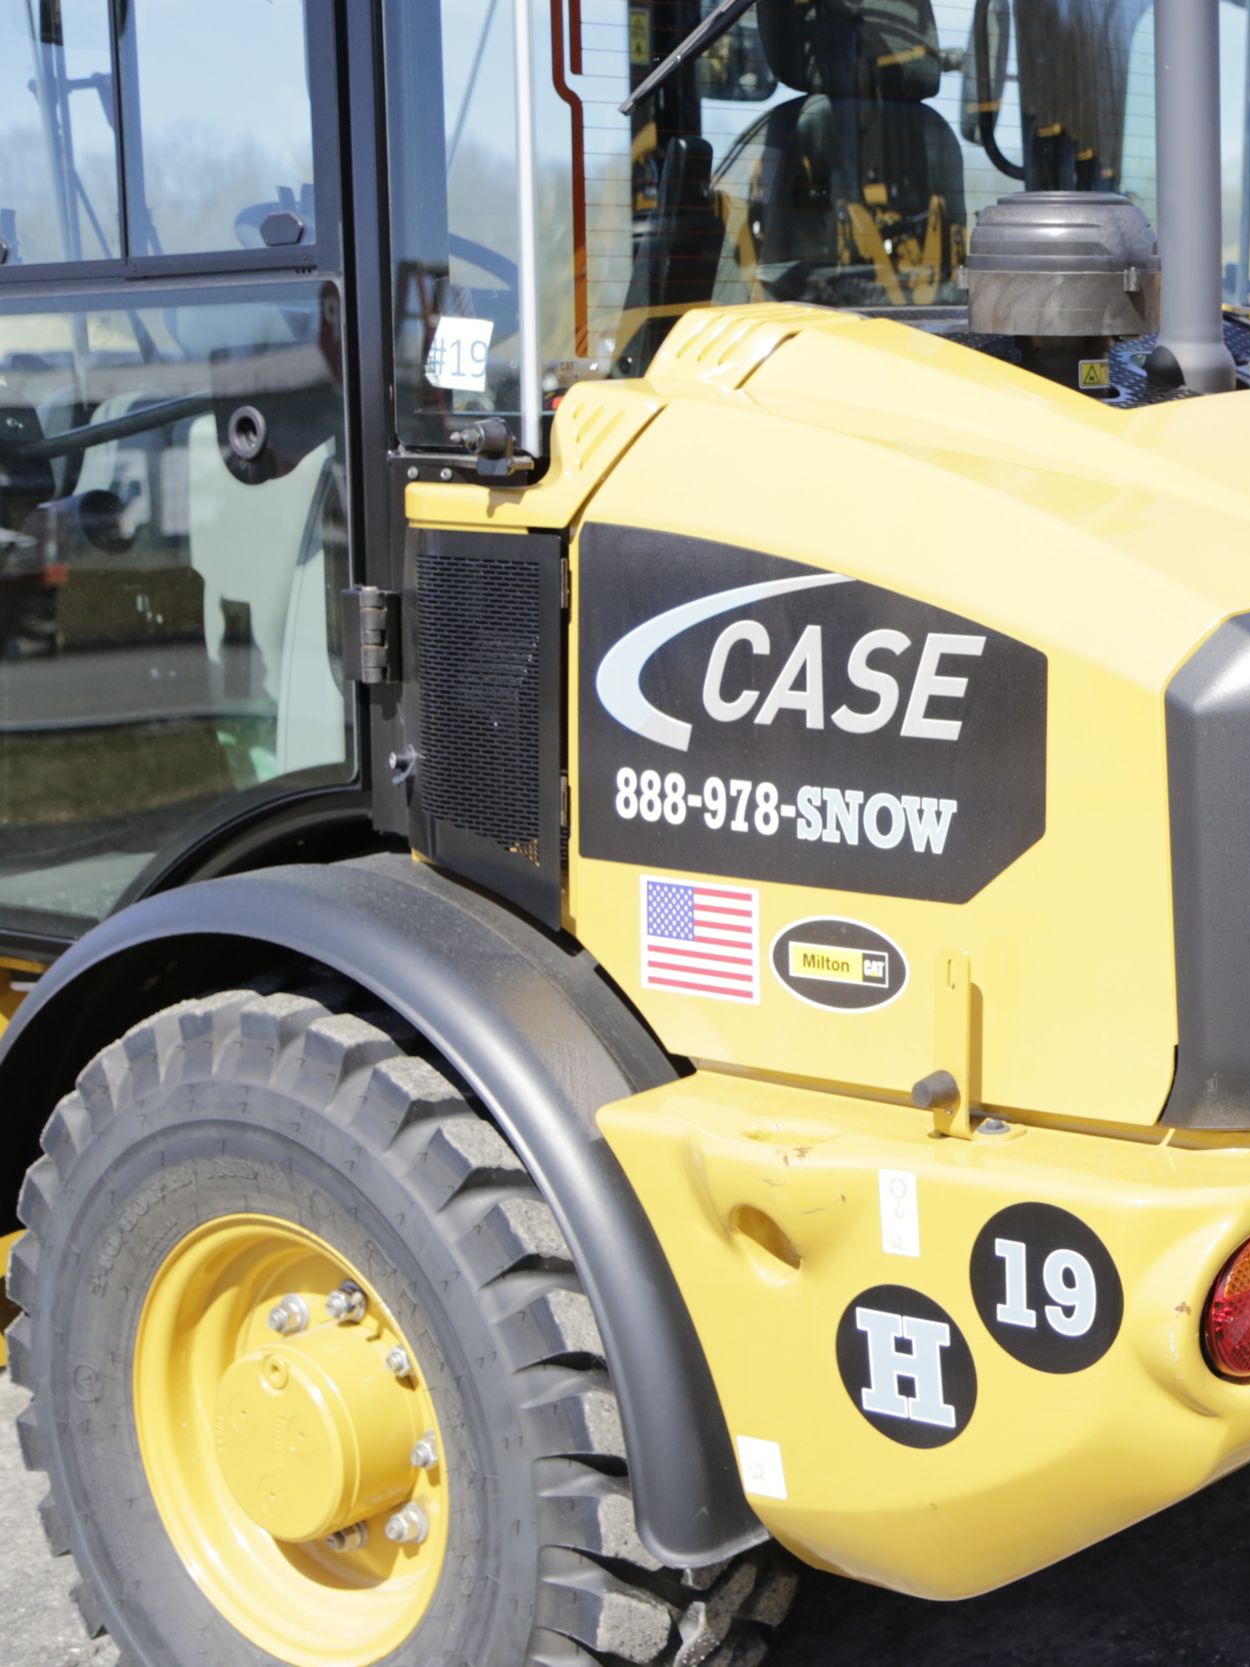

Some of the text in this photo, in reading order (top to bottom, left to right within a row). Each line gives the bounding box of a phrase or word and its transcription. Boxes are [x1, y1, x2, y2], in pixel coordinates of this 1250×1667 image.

[431, 338, 489, 378] #19
[702, 619, 987, 741] CASE
[615, 766, 958, 854] 888-978-SNOW
[802, 952, 885, 978] Milton CAT
[993, 1237, 1097, 1338] 19
[854, 1306, 957, 1429] H
